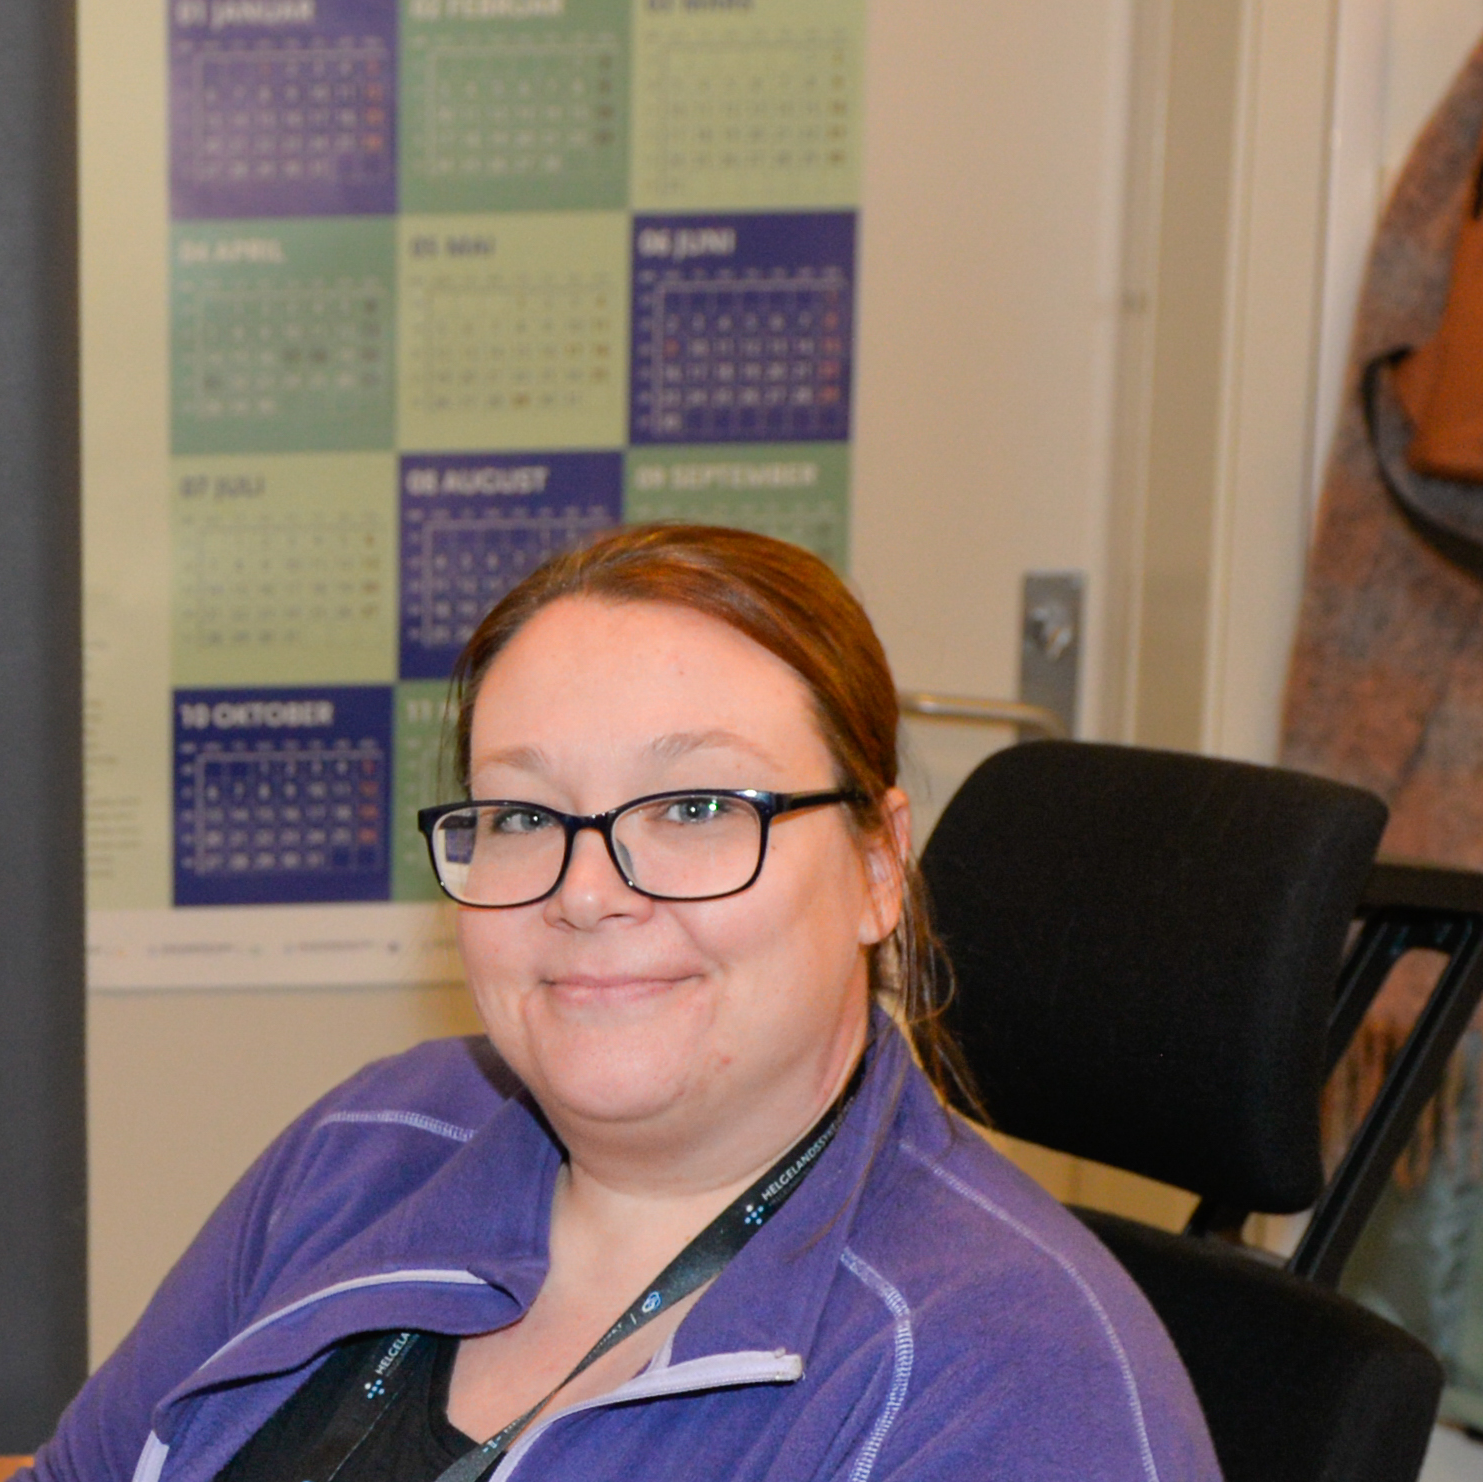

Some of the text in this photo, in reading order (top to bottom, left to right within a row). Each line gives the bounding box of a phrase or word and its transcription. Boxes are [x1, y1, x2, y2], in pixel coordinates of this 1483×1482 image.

[673, 228, 736, 262] JUNI
[440, 465, 550, 496] AUGUST
[212, 701, 334, 728] OKTOBER
